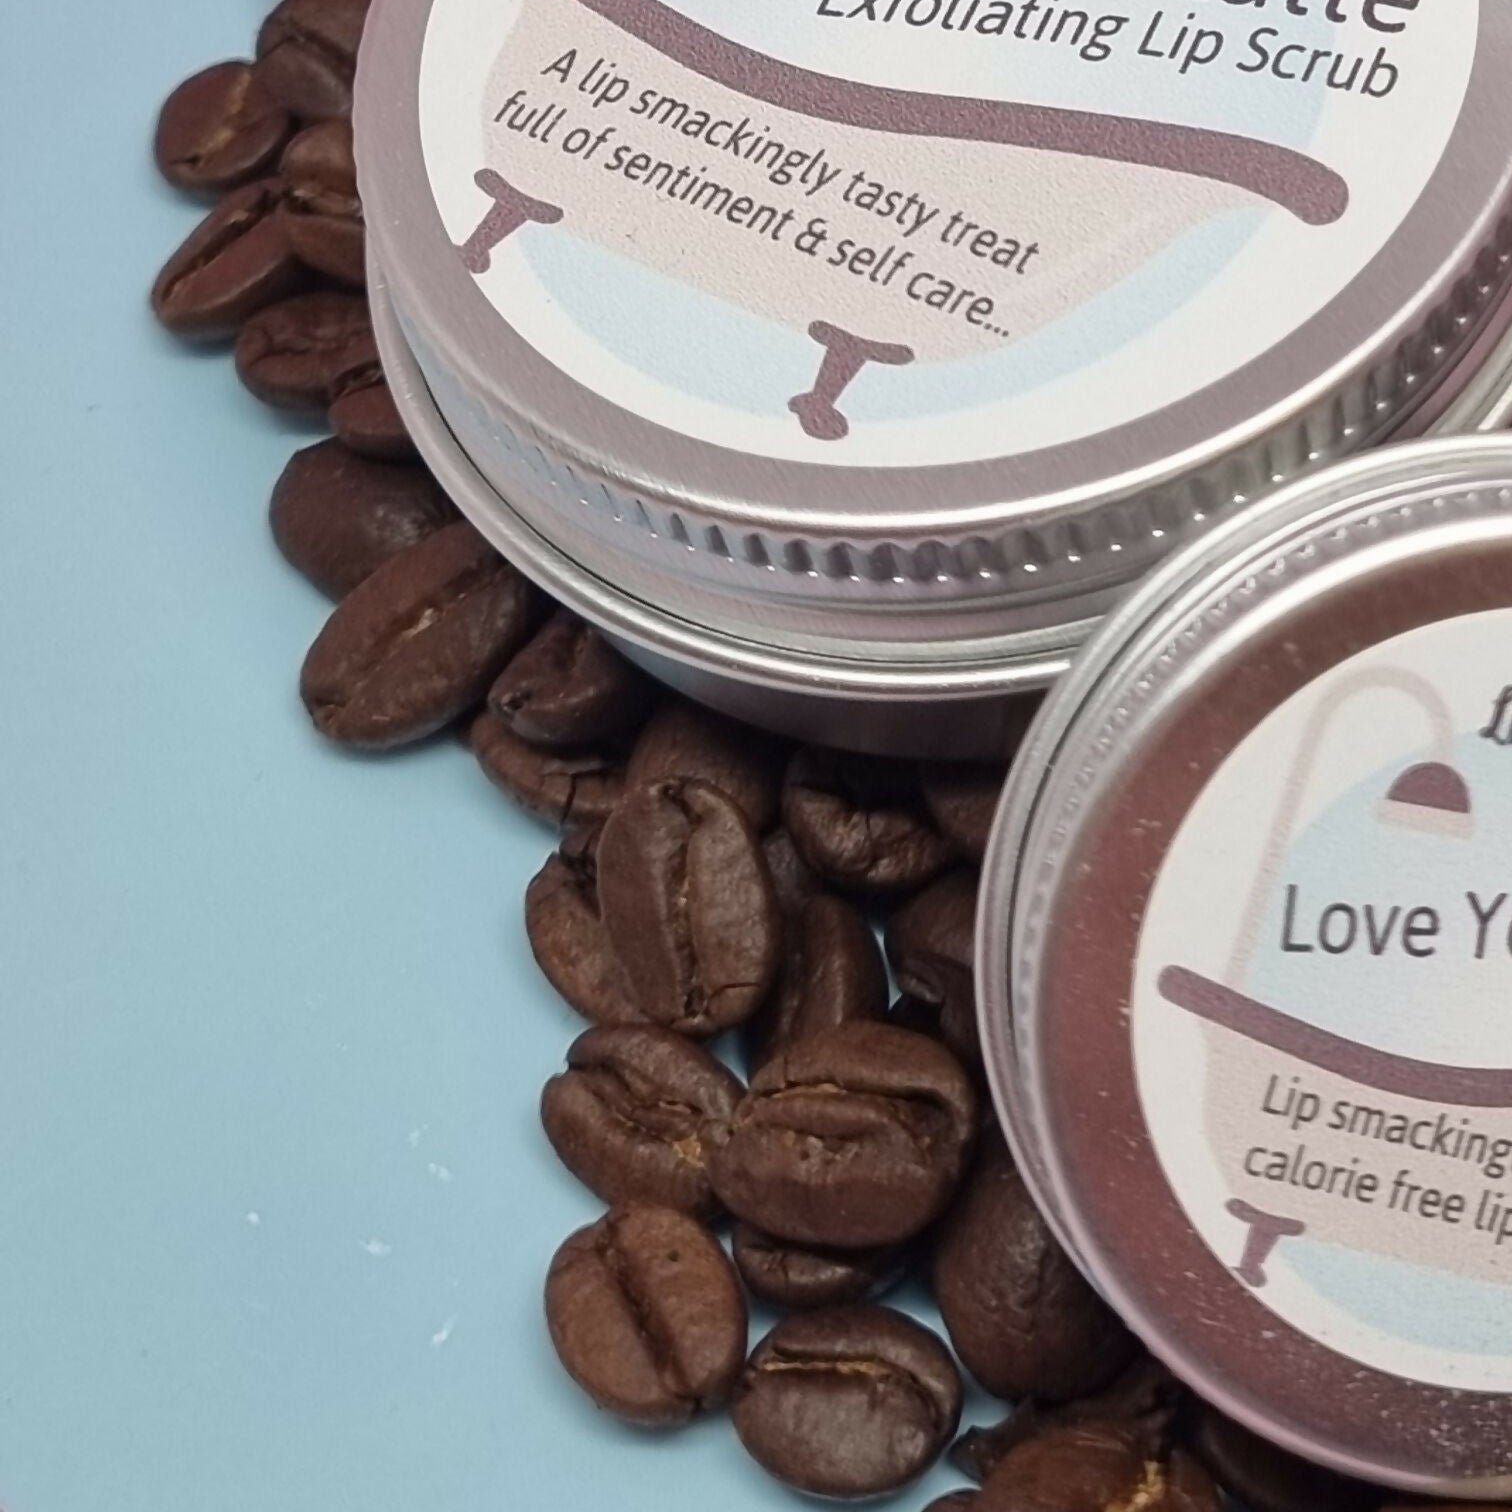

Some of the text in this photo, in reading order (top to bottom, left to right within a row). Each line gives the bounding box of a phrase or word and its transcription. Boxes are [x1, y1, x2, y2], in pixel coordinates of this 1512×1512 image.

[1138, 11, 1223, 74] Lip
[1236, 28, 1398, 97] Scrub
[541, 49, 1039, 274] A lip smackingly tasty treat
[494, 91, 1008, 337] full of sentiment & self care...
[1281, 884, 1439, 957] Love
[1262, 1075, 1320, 1130] Lip
[1244, 1145, 1379, 1203] calorie
[1388, 1170, 1465, 1223] free
